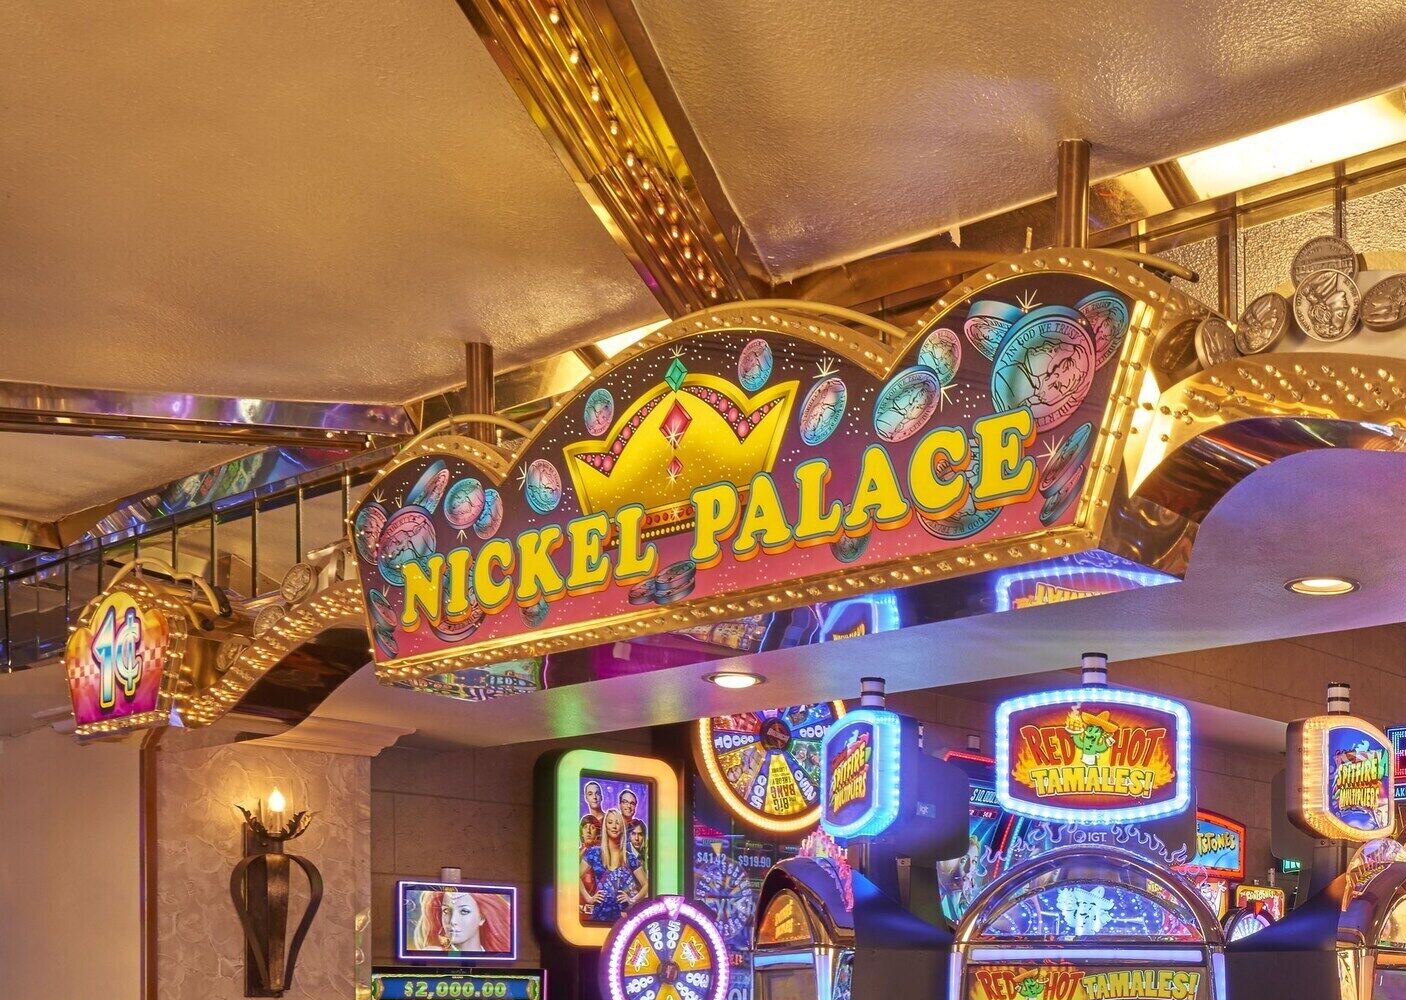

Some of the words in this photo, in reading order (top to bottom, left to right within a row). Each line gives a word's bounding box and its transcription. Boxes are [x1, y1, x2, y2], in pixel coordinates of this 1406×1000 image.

[401, 503, 656, 632] NICKEL
[690, 406, 1037, 568] PALACE
[93, 605, 144, 709] 1¢
[1020, 725, 1077, 766] RED
[1109, 727, 1167, 767] HOT
[1030, 767, 1156, 798] TAMALES!
[1337, 760, 1378, 785] SPITFIRE
[771, 783, 796, 797] BANG
[1088, 832, 1106, 842] IGT
[404, 981, 507, 999] $2,000.00
[976, 970, 1016, 1000] RED
[1043, 971, 1085, 1000] HOT
